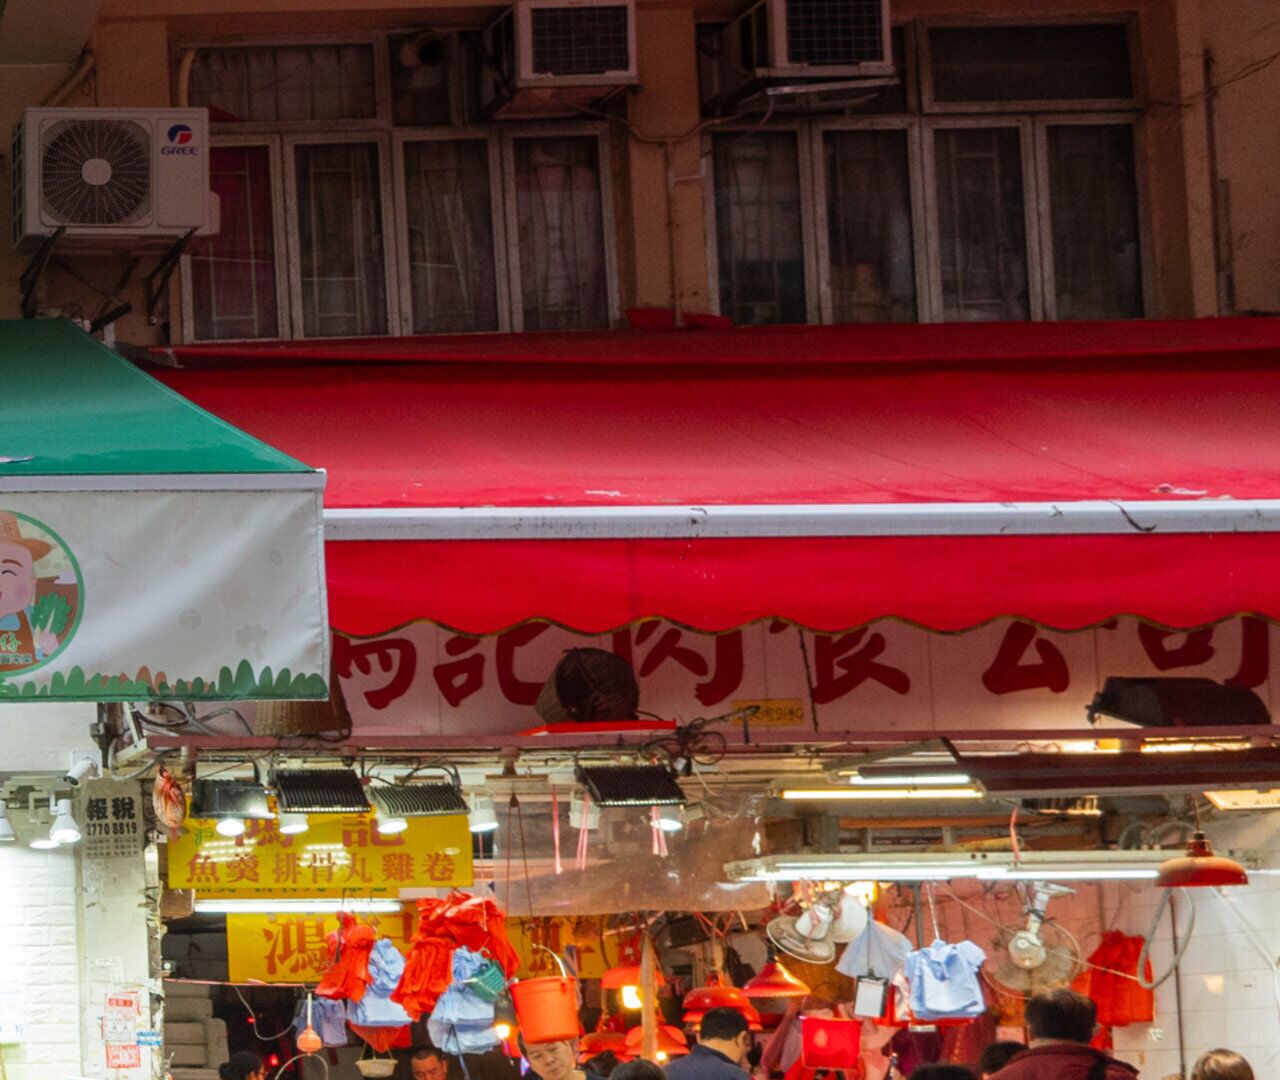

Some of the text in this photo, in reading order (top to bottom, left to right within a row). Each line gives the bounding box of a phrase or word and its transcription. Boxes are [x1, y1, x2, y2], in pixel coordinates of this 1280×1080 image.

[161, 146, 199, 156] GREE
[86, 796, 136, 821] 報稅
[86, 822, 137, 836] 2770 8819
